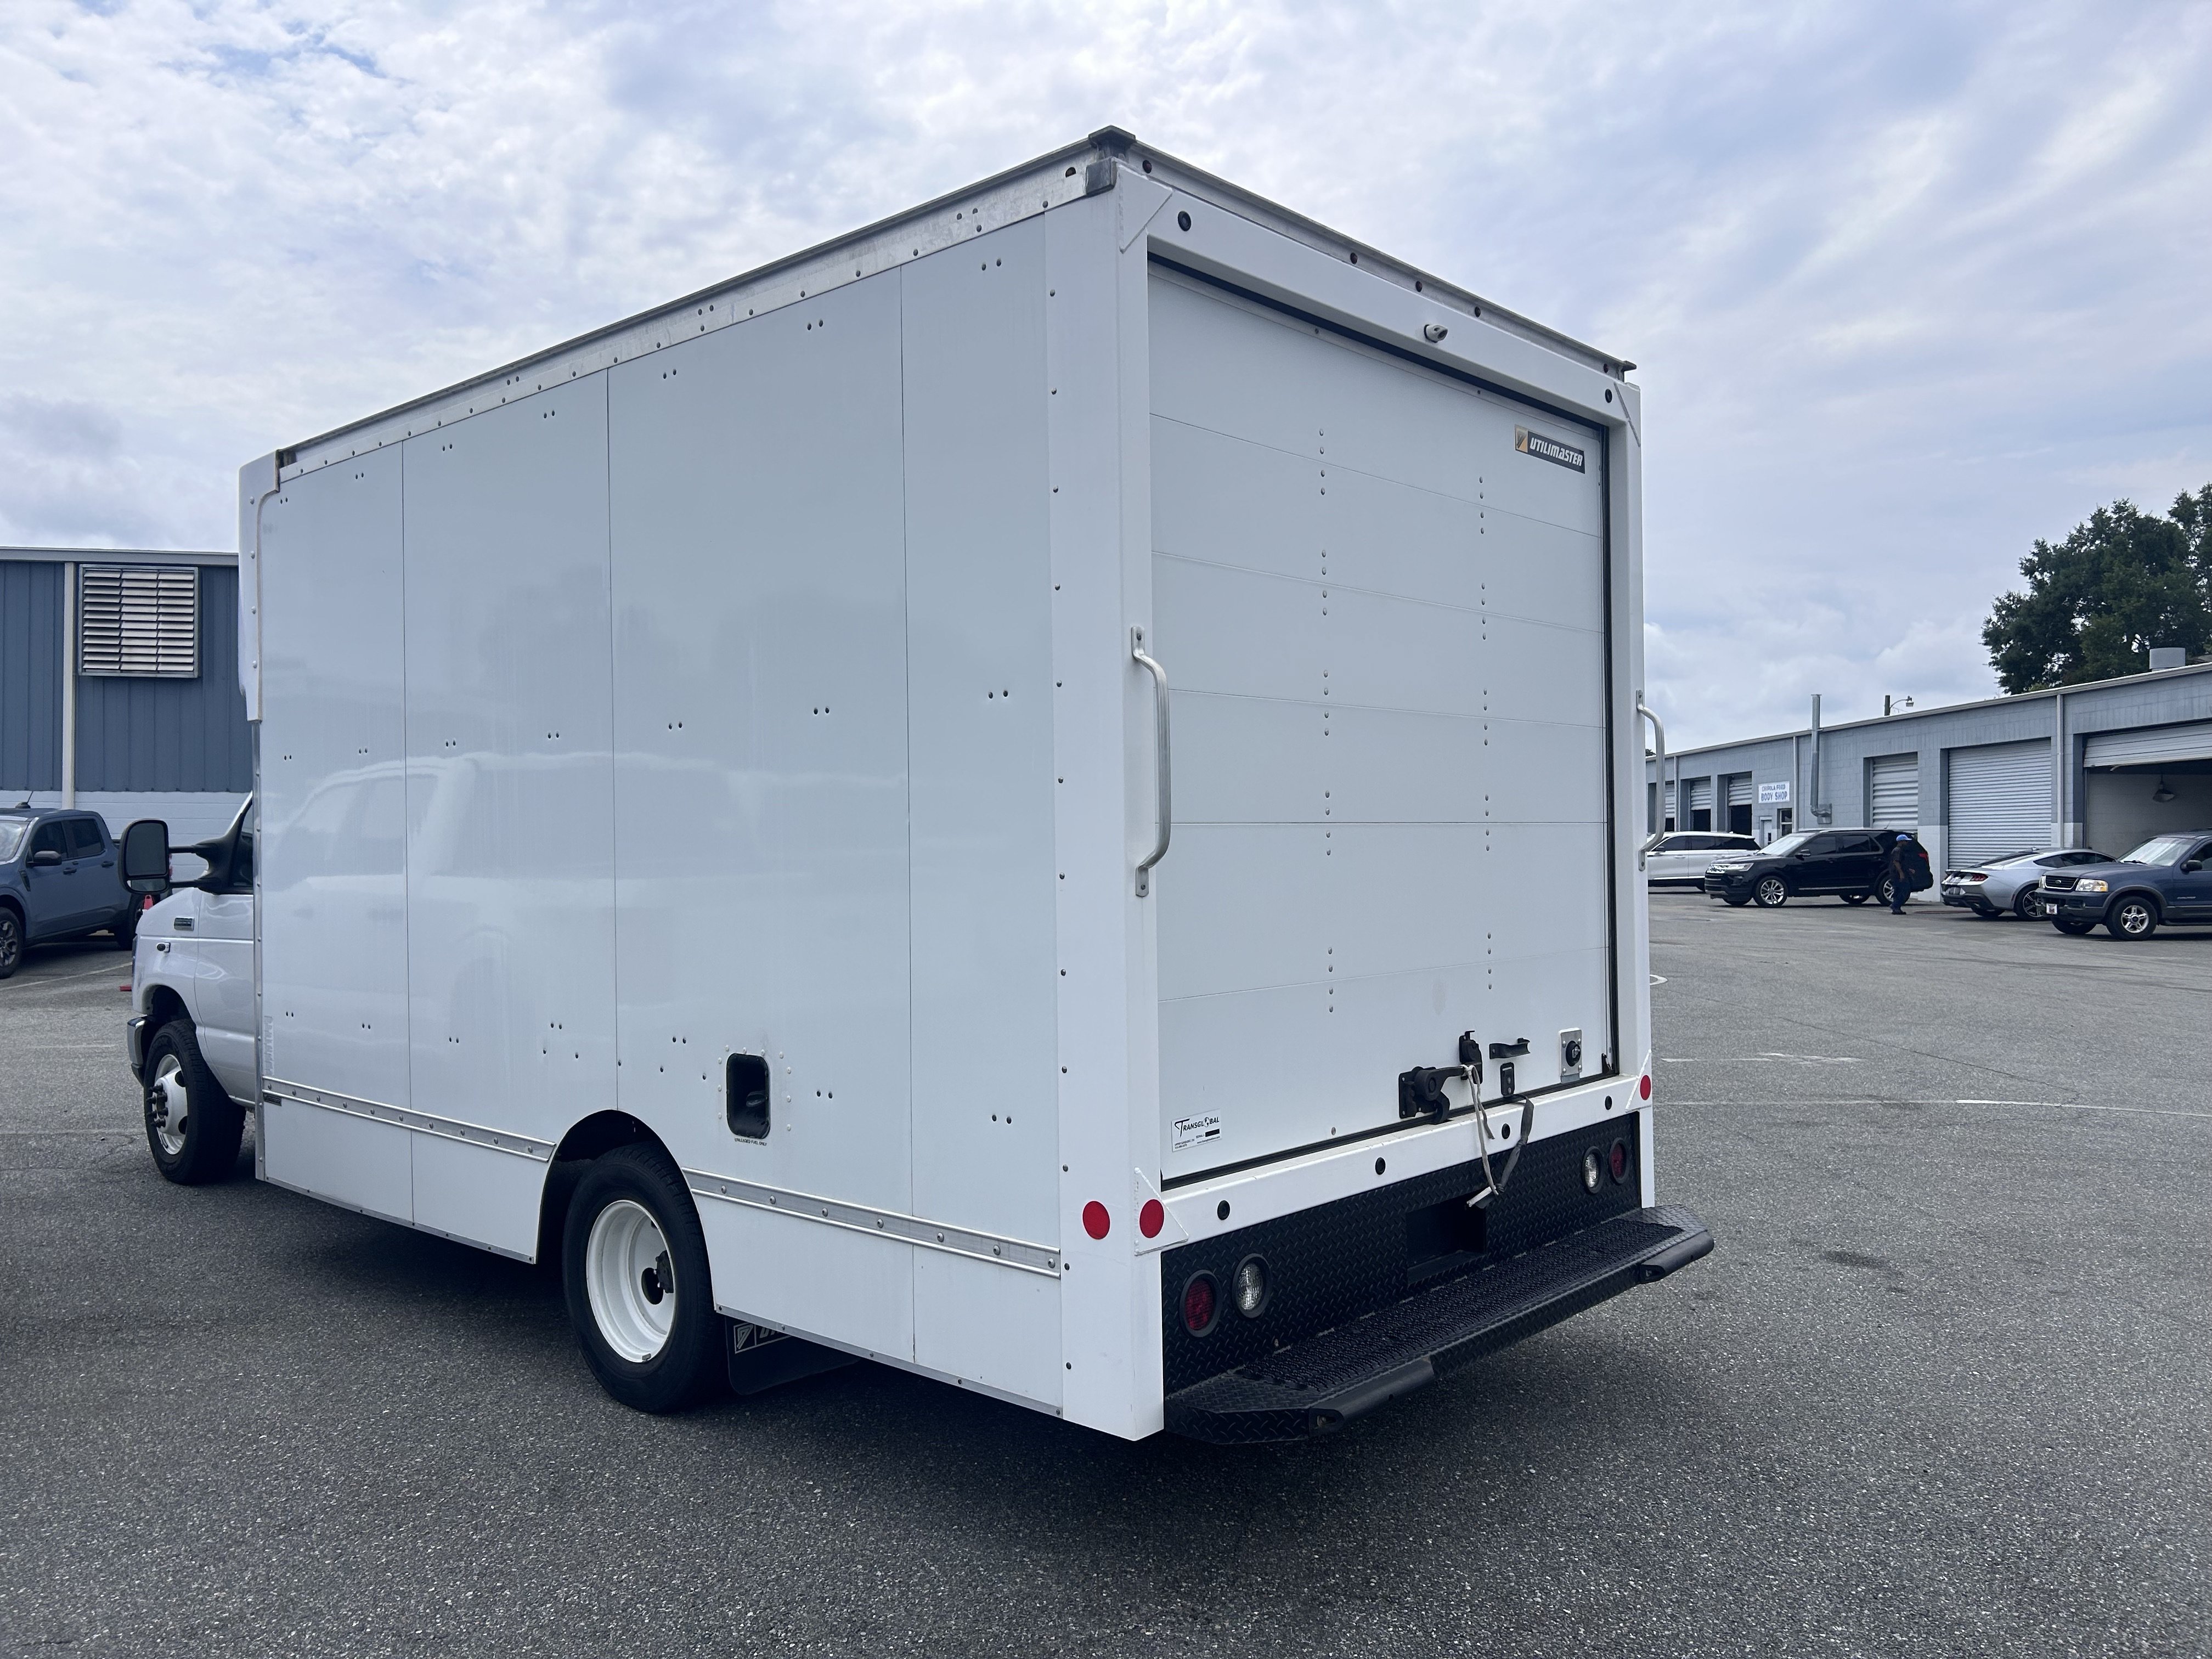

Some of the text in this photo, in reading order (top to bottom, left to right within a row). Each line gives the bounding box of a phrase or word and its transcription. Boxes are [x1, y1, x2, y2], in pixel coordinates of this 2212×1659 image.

[1530, 437, 1583, 466] UTILIMASTER
[1762, 791, 1787, 802] BODY SHOP
